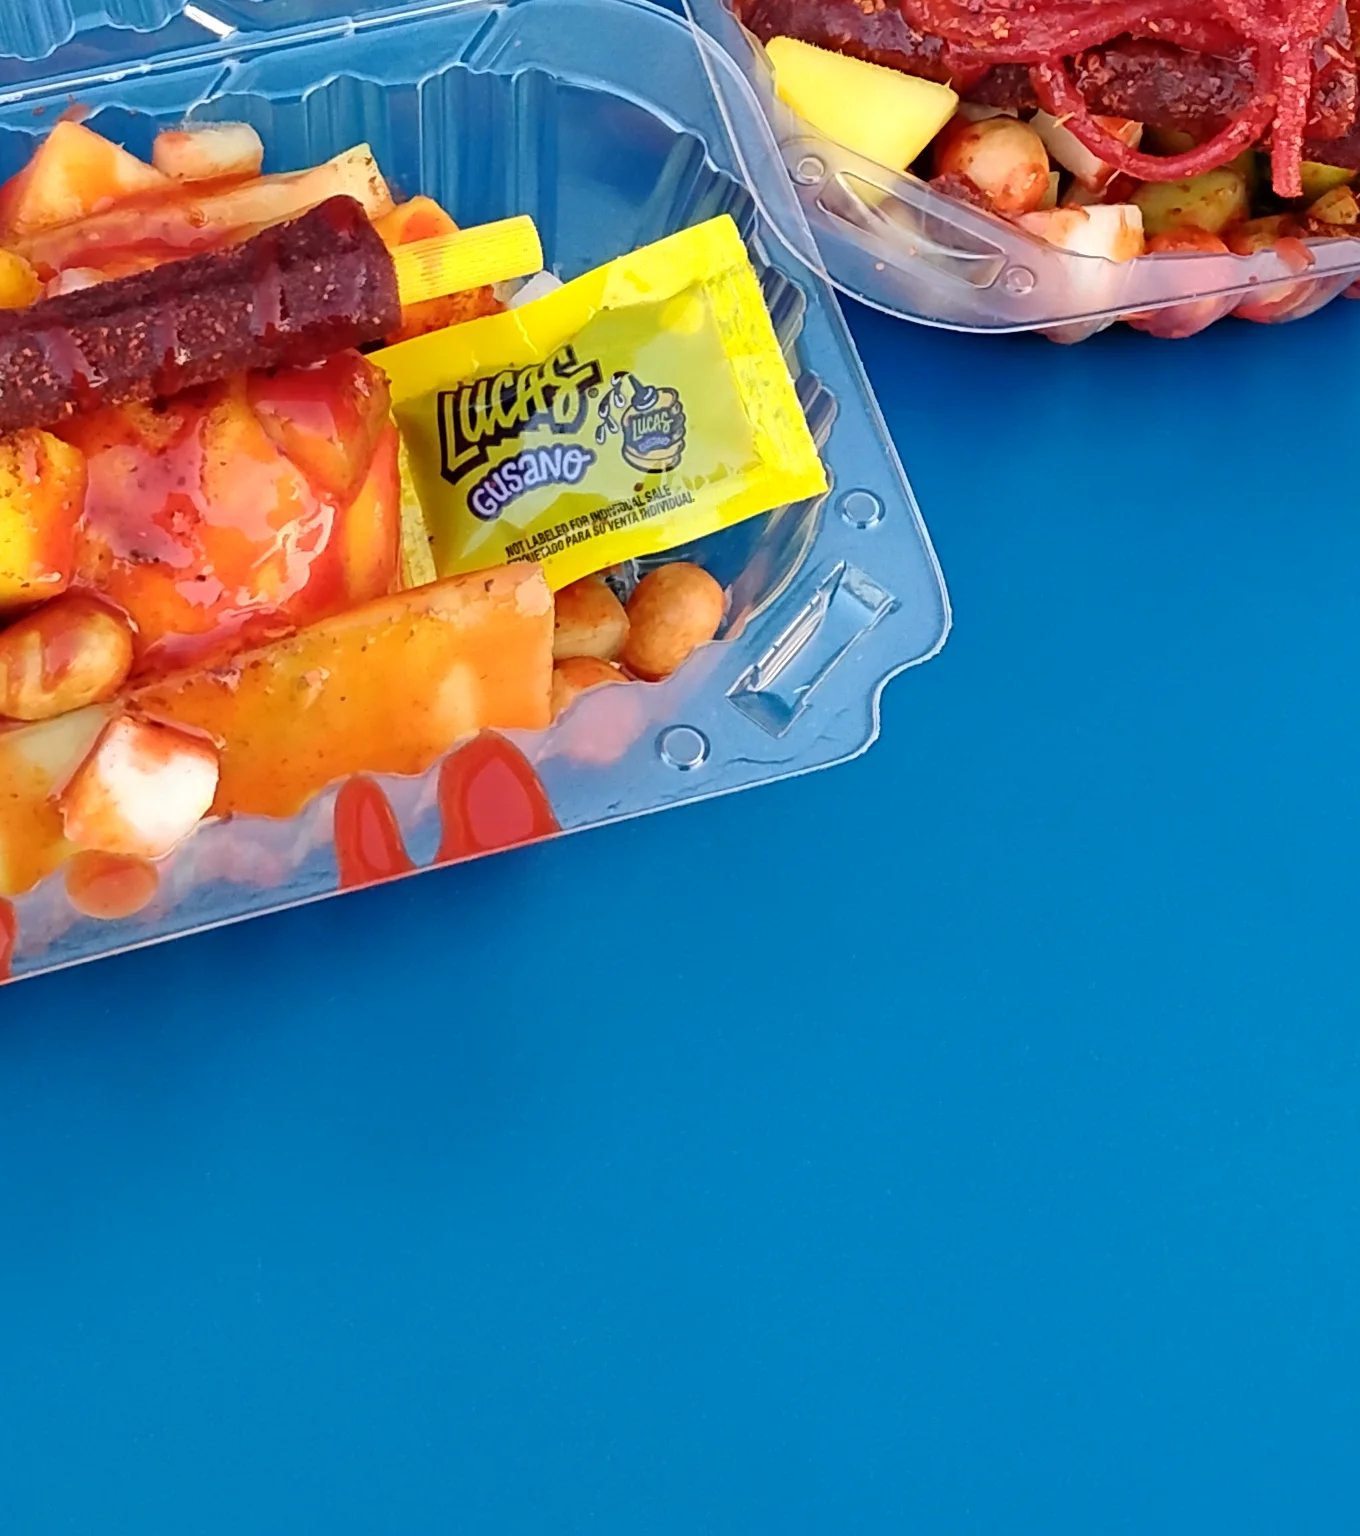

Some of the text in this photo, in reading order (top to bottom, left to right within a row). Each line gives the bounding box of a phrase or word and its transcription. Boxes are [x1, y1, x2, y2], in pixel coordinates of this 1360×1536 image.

[440, 347, 601, 478] LUCAS
[632, 411, 674, 442] LUCAS
[470, 445, 594, 520] GUSANO
[505, 539, 526, 557] NOT
[525, 522, 570, 552] LABELED
[569, 516, 591, 532] FOR
[645, 483, 672, 503] SALE
[565, 530, 592, 548] PARA
[592, 522, 607, 537] SU
[608, 512, 640, 533] VENTA
